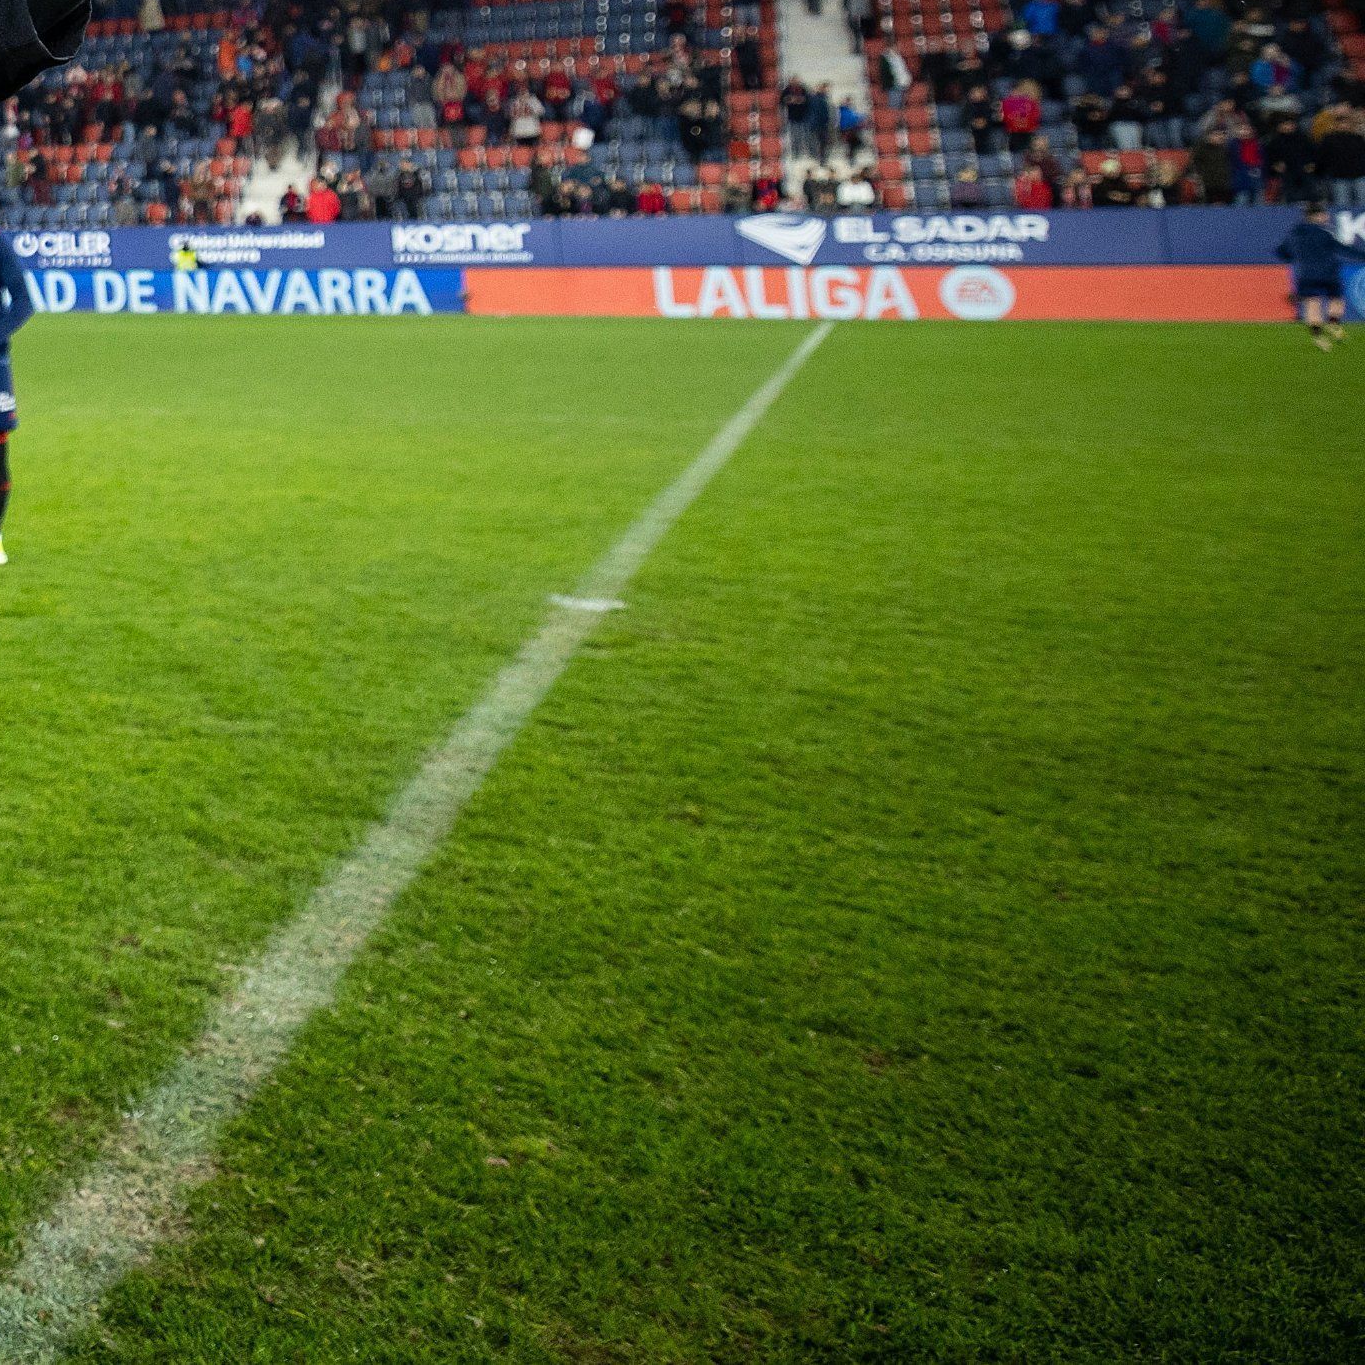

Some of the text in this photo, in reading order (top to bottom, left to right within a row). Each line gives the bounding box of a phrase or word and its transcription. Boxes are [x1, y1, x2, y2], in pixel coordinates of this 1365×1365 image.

[38, 231, 111, 256] CELER
[834, 214, 1049, 243] EL SADAR
[92, 268, 159, 314] DE
[172, 268, 433, 316] NAVARRA
[653, 265, 919, 320] LALIGA
